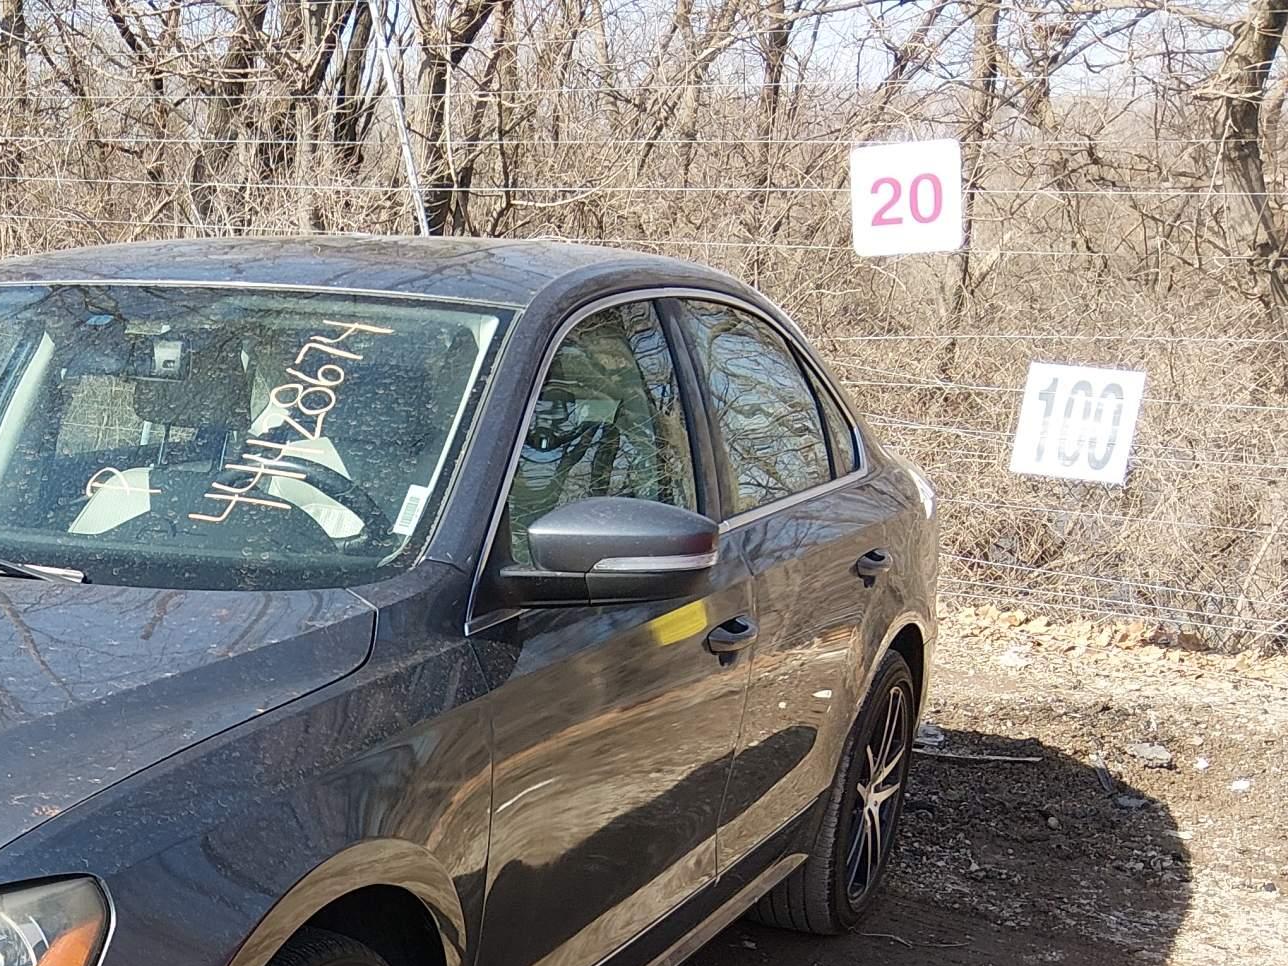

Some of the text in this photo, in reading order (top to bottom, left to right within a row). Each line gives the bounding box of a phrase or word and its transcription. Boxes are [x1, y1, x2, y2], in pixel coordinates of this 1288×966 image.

[870, 172, 943, 227] 20
[188, 319, 395, 522] 44428674
[1034, 376, 1125, 471] 100
